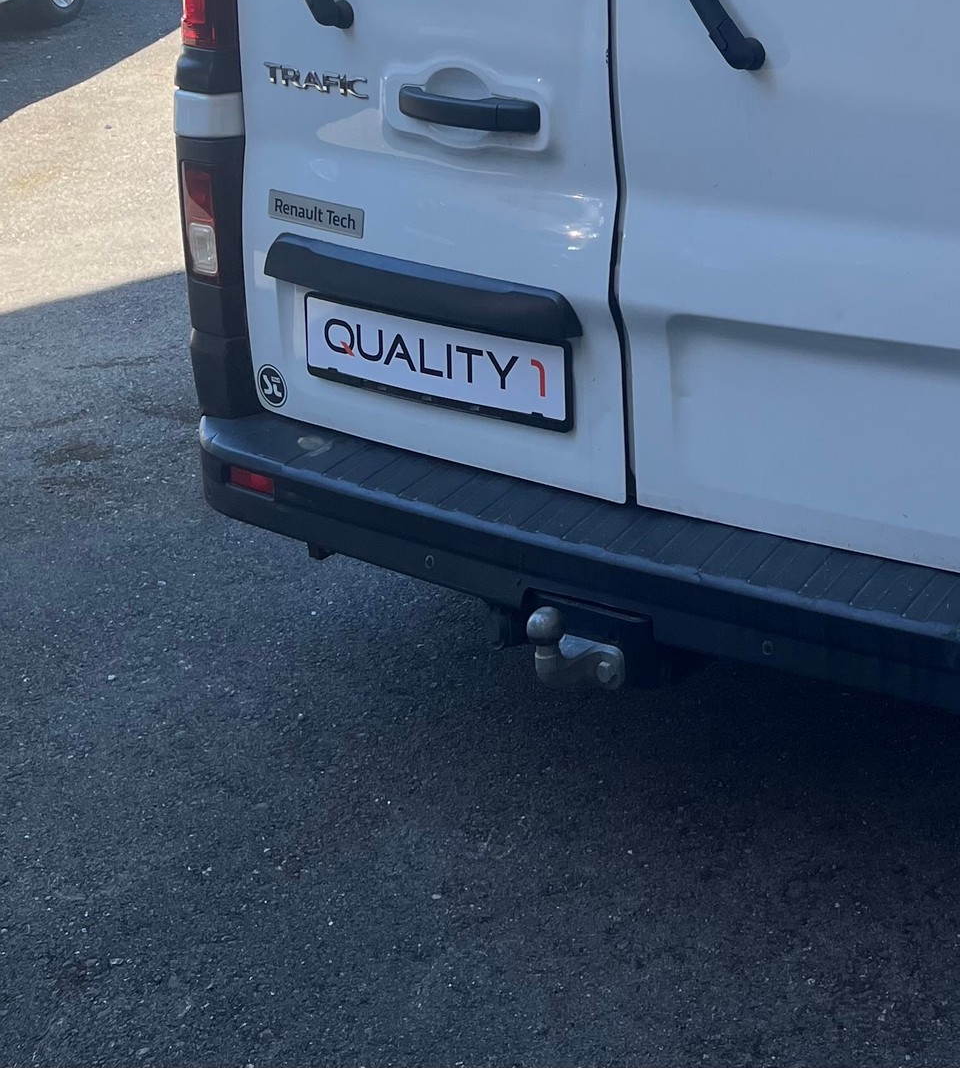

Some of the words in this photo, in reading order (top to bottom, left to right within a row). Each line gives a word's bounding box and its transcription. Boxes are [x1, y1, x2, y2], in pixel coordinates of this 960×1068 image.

[263, 61, 369, 100] TRAFIC
[274, 198, 324, 223] Renault
[326, 209, 356, 230] Tech
[323, 318, 519, 390] QUALITY
